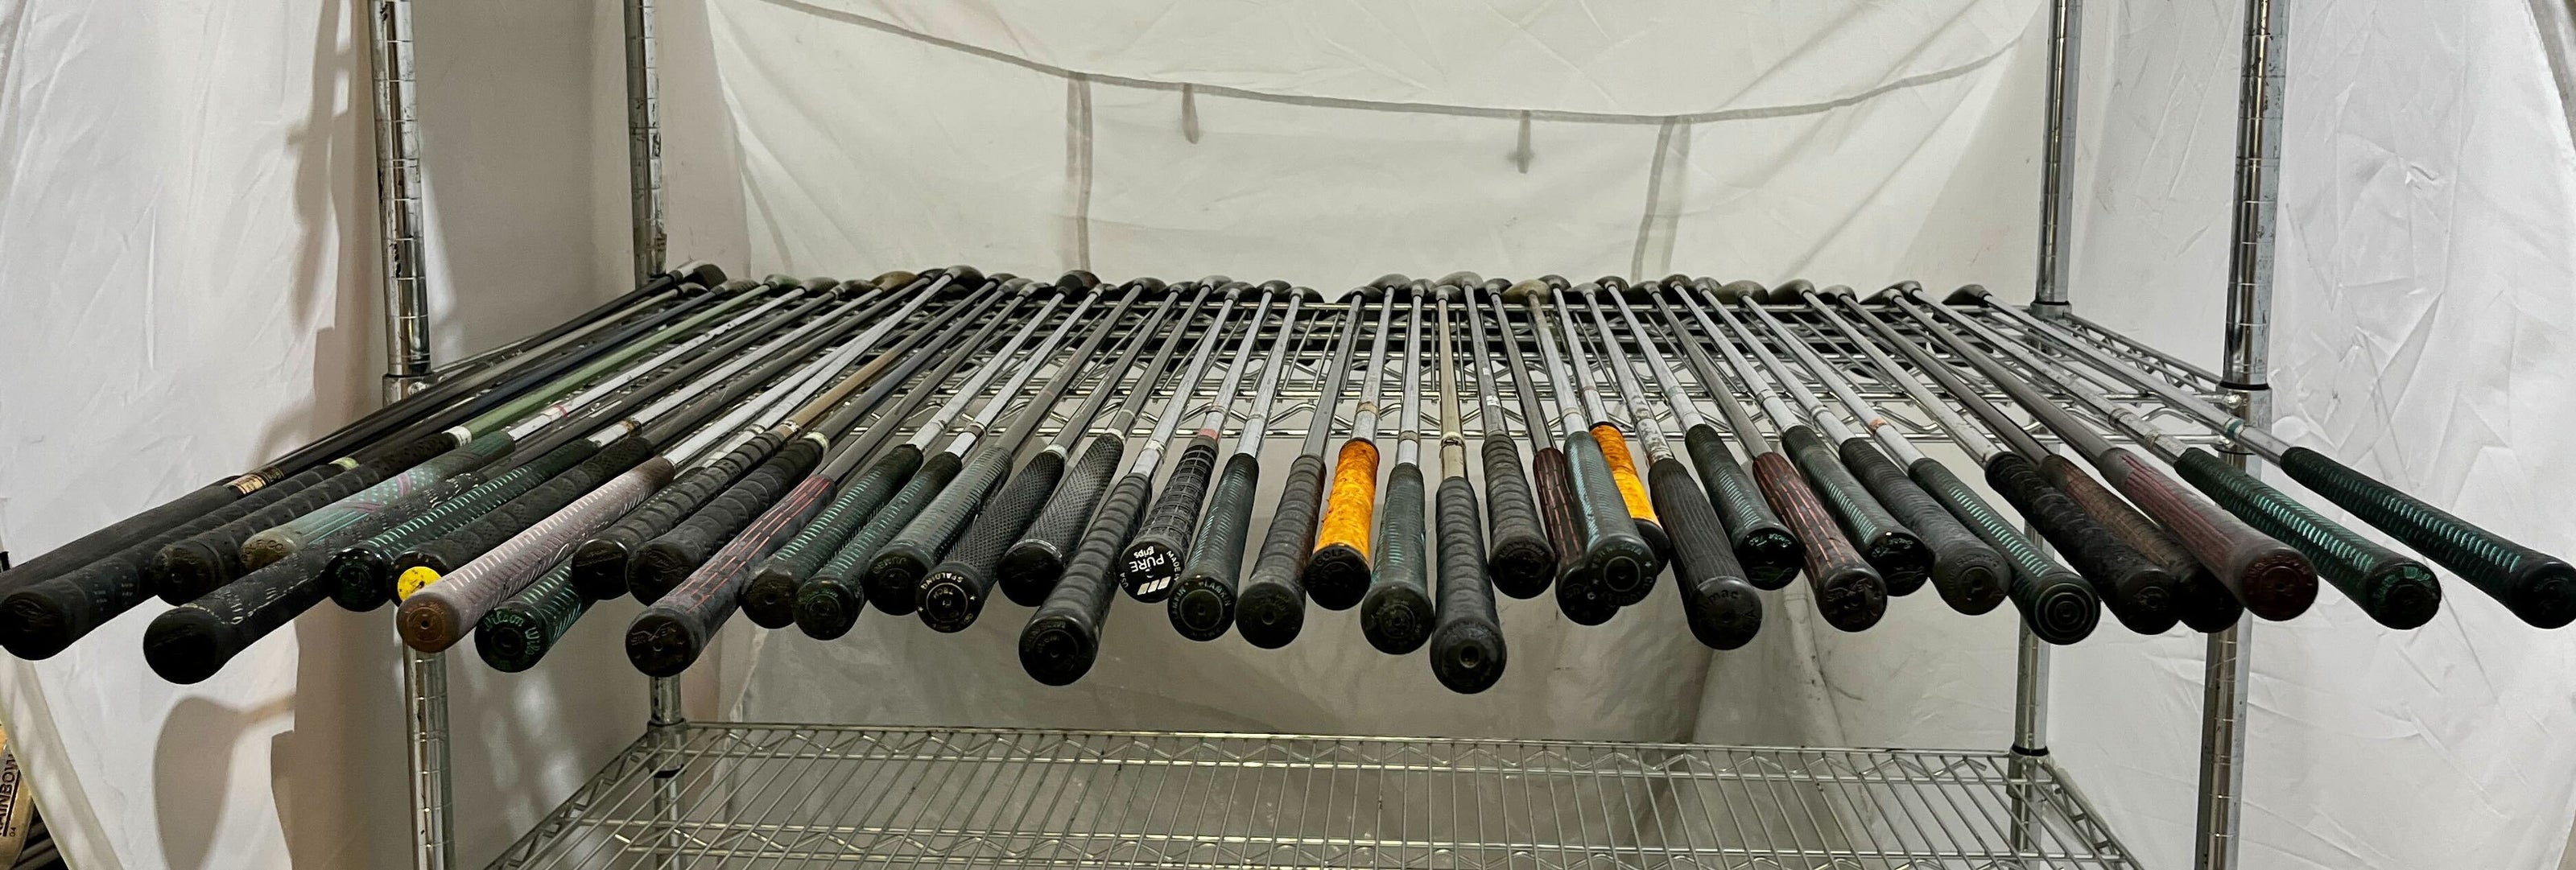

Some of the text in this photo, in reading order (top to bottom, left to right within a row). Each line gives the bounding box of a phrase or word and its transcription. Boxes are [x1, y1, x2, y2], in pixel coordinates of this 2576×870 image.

[1133, 546, 1154, 559] grips
[1166, 550, 1182, 572] MADE
[1315, 549, 1346, 566] GOLF
[1129, 554, 1165, 573] PURE
[920, 572, 964, 590] SPALDING
[1120, 572, 1129, 588] USA
[1204, 579, 1232, 607] LAMKIN
